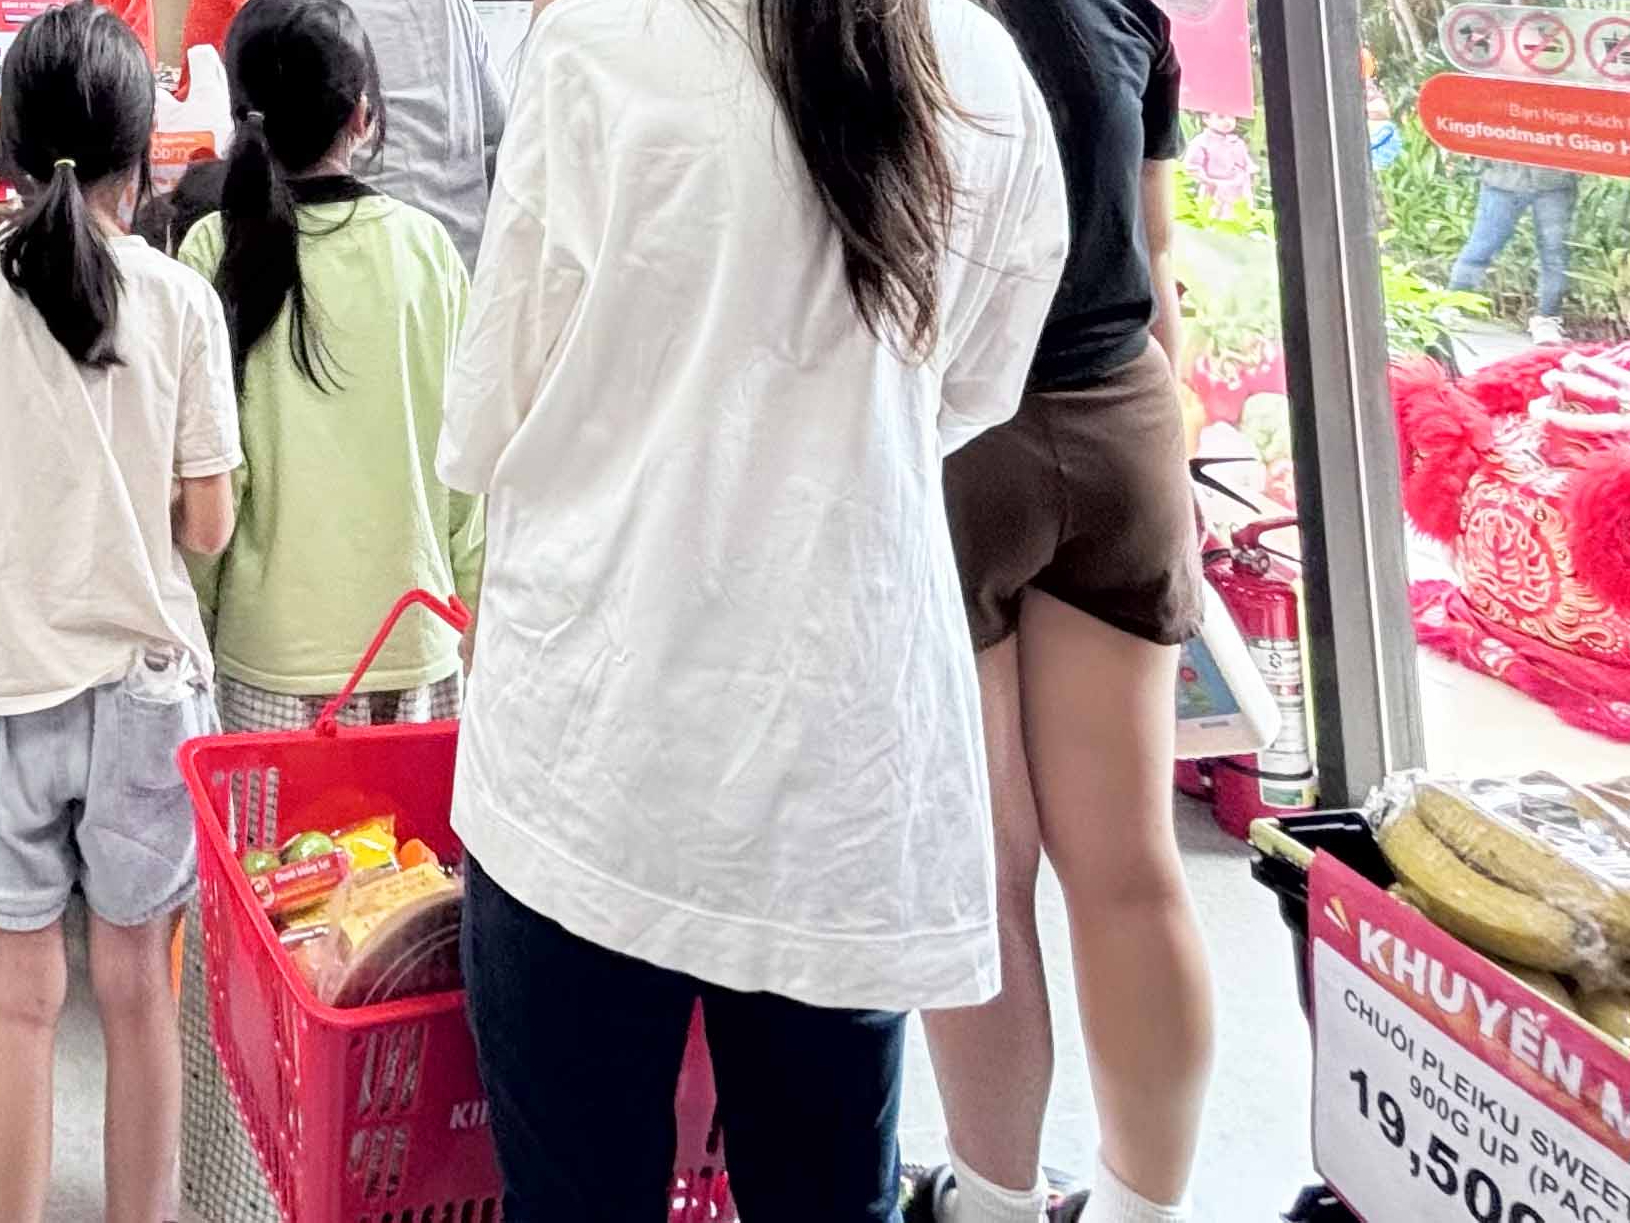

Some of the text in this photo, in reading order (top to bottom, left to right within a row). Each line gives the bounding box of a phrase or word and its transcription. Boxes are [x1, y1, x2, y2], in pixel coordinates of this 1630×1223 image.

[1435, 116, 1615, 154] Kingfoodmart Giao
[1359, 918, 1584, 1099] KHUYẾN
[1410, 1075, 1519, 1166] 900G UP
[1422, 1047, 1519, 1137] PLEIKU
